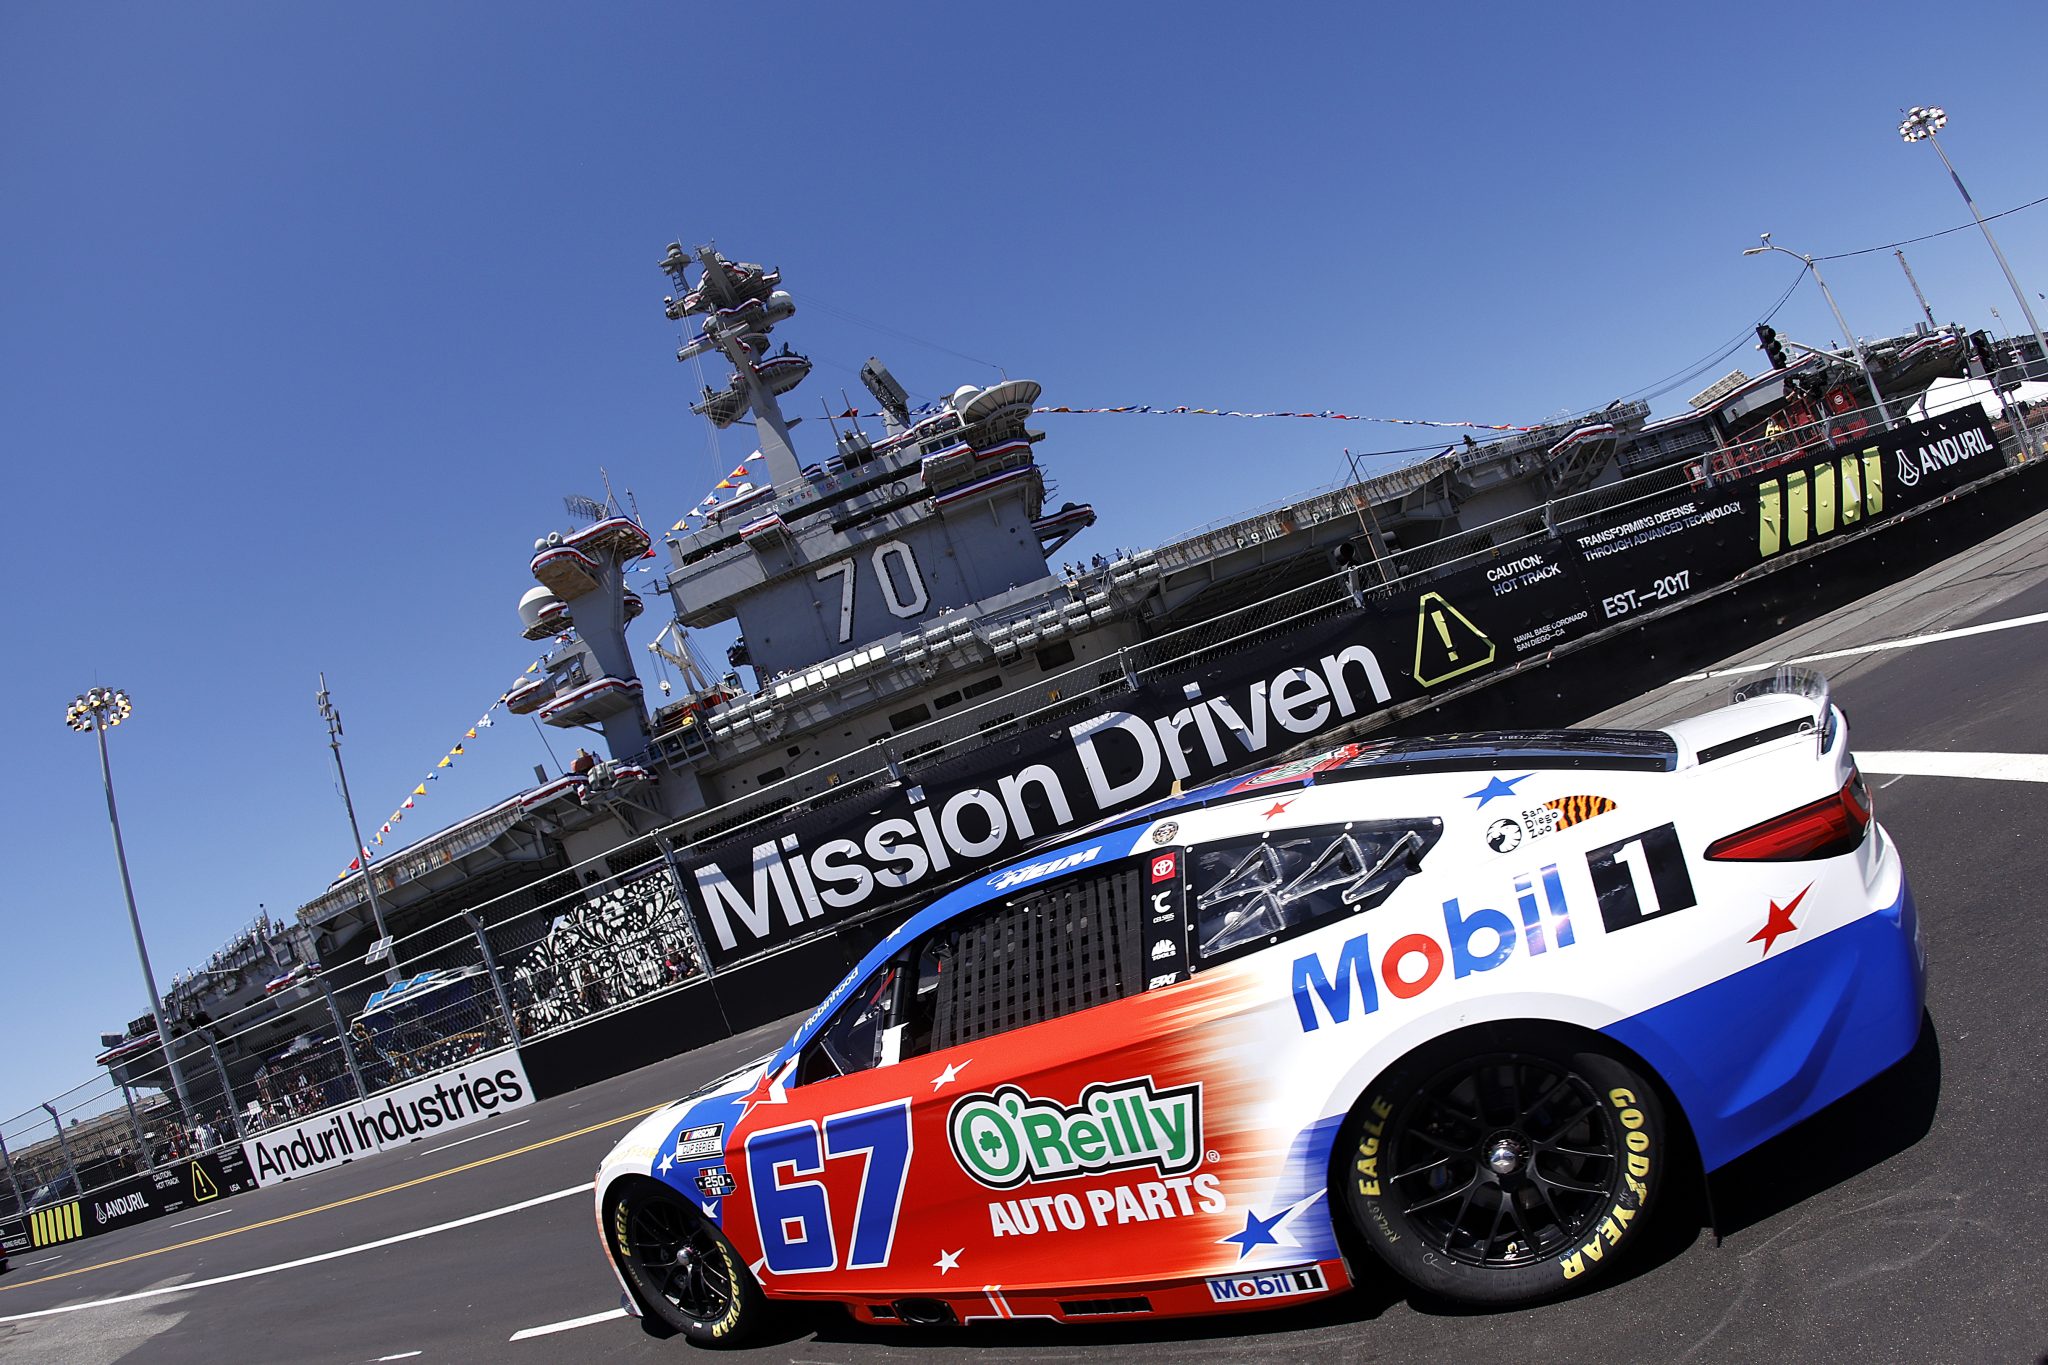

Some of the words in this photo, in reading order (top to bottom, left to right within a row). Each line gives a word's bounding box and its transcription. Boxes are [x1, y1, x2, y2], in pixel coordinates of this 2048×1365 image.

[1918, 427, 1993, 475] ANDURIL
[1250, 532, 1261, 543] 9
[1577, 515, 1656, 549] TRANSFORMING
[1654, 502, 1697, 524] DEFENSE
[1583, 536, 1635, 562] THROUGH
[1633, 521, 1683, 546] ADVANCED
[1682, 501, 1742, 530] TECHNOLOGY
[1486, 553, 1544, 582] CAUTION:
[1492, 578, 1521, 597] HOT
[1520, 563, 1562, 587] TRACK
[815, 540, 930, 645] 70
[1513, 630, 1534, 645] NAVAL
[1533, 624, 1552, 638] BASE
[1551, 611, 1588, 632] CORONADO
[1516, 641, 1531, 652] SAN
[694, 763, 1075, 951] Mission
[1069, 644, 1392, 801] Driven
[1521, 806, 1544, 821] San
[1525, 811, 1559, 830] Diego
[1528, 825, 1552, 839] Zoo
[994, 845, 1103, 891] HEIM
[1292, 862, 1577, 1033] Mobil
[1611, 837, 1665, 915] 1
[1152, 950, 1177, 961] TOOLS
[803, 967, 859, 1031] Robinhood
[255, 1115, 354, 1181] Anduril
[348, 1069, 523, 1151] Industries
[690, 1127, 718, 1139] NASCAR
[960, 1094, 1186, 1177] O'Reilly
[682, 1145, 694, 1155] CUP
[694, 1141, 715, 1152] SERIES
[1356, 1095, 1393, 1197] EAGLE
[229, 1183, 241, 1192] USA
[704, 1175, 726, 1188] 250
[745, 1097, 912, 1276] 67
[105, 1192, 149, 1219] ANDURIL
[988, 1193, 1086, 1238] AUTO
[1085, 1173, 1227, 1227] PARTS
[616, 1201, 632, 1257] EAGLE
[1209, 1272, 1291, 1300] Mobil
